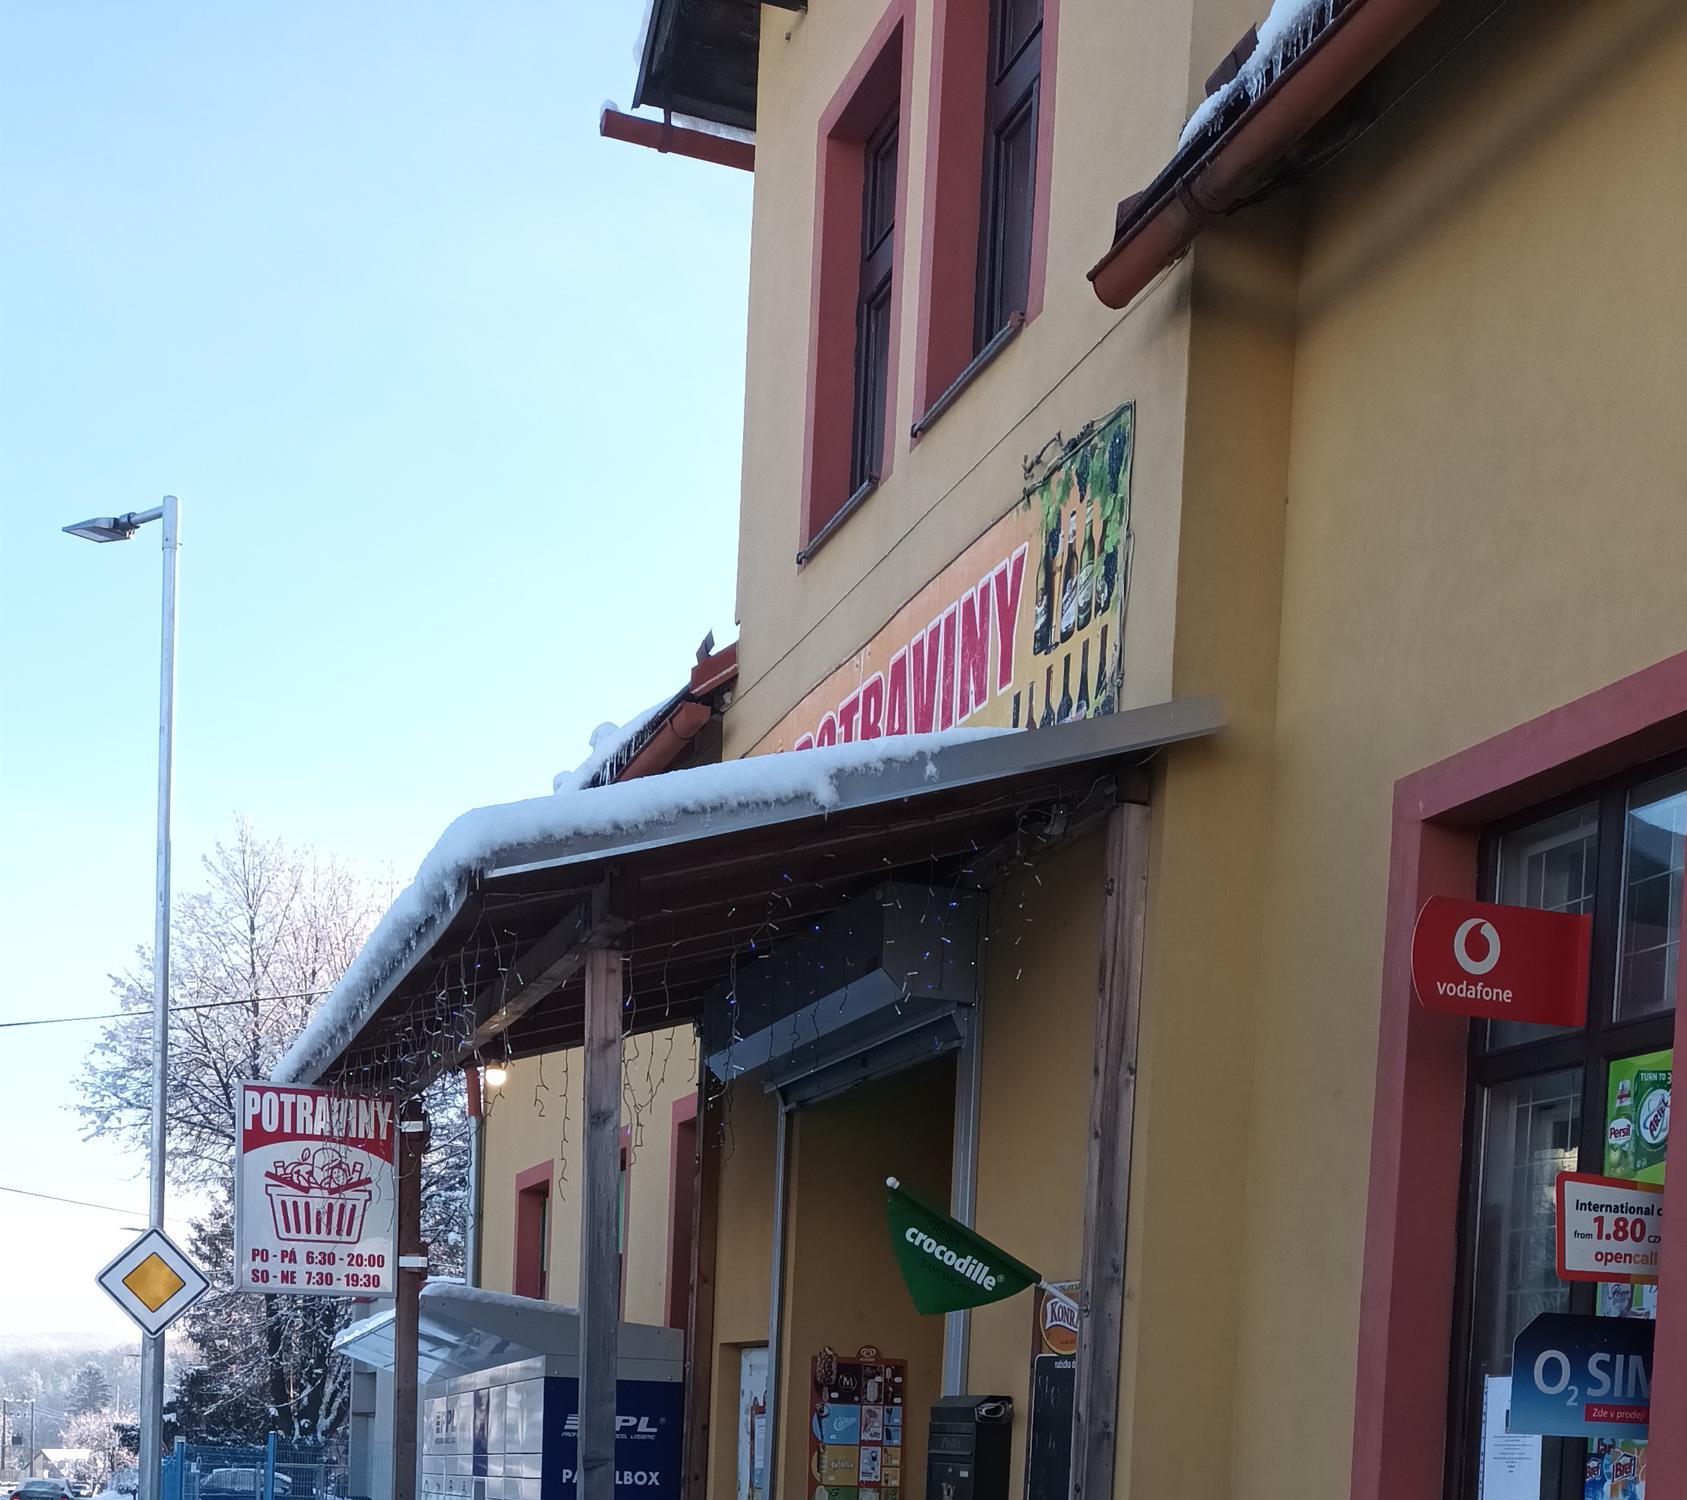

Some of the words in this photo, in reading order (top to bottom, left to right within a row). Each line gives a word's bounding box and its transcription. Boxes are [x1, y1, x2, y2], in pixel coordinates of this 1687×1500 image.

[794, 541, 1029, 754] TRAVINY
[1437, 981, 1512, 1003] vodafone
[1640, 1072, 1658, 1081] TURN
[1658, 1073, 1667, 1081] TO
[244, 1090, 392, 1140] POTRAVINY
[1649, 1098, 1669, 1134] ARIEL
[1609, 1124, 1631, 1139] Persil
[1575, 1199, 1655, 1216] International
[1656, 1207, 1663, 1216] c
[1573, 1229, 1593, 1240] from
[1593, 1215, 1647, 1243] 1.80
[251, 1248, 269, 1263] PO
[280, 1247, 298, 1264] PÁ
[305, 1250, 336, 1266] 6:30
[346, 1252, 385, 1268] 20:00
[905, 1227, 997, 1291] crocodille
[251, 1268, 270, 1283] SO
[281, 1270, 297, 1285] NE
[305, 1271, 334, 1286] 7:30
[344, 1273, 380, 1288] 19:30
[1050, 1301, 1078, 1329] KONR
[1592, 1407, 1608, 1418] Zde
[1610, 1410, 1616, 1418] v
[1614, 1460, 1634, 1480] Bref
